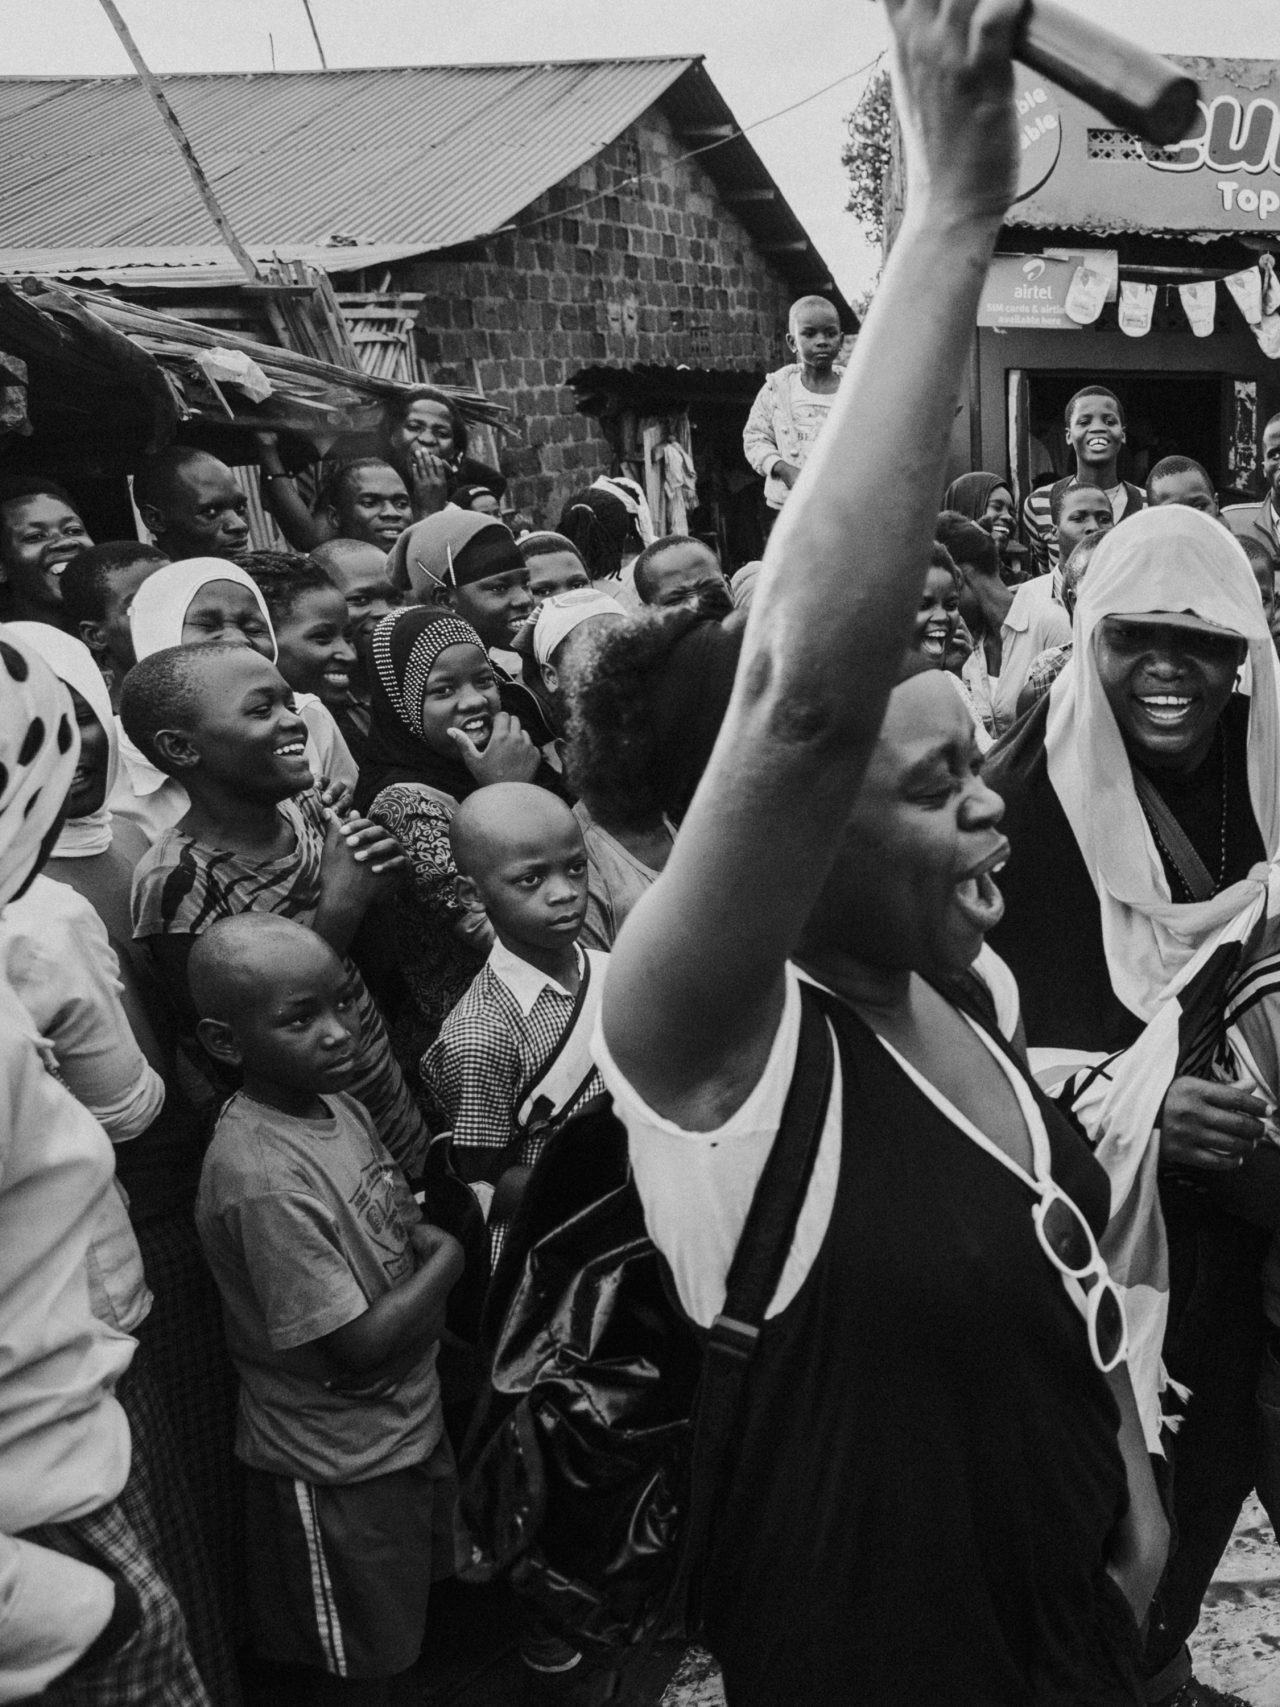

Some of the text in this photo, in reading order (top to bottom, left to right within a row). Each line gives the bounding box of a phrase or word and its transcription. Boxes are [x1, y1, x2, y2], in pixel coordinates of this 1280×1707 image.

[1016, 88, 1048, 118] ble
[1217, 181, 1280, 220] Top
[1014, 284, 1053, 299] airtel
